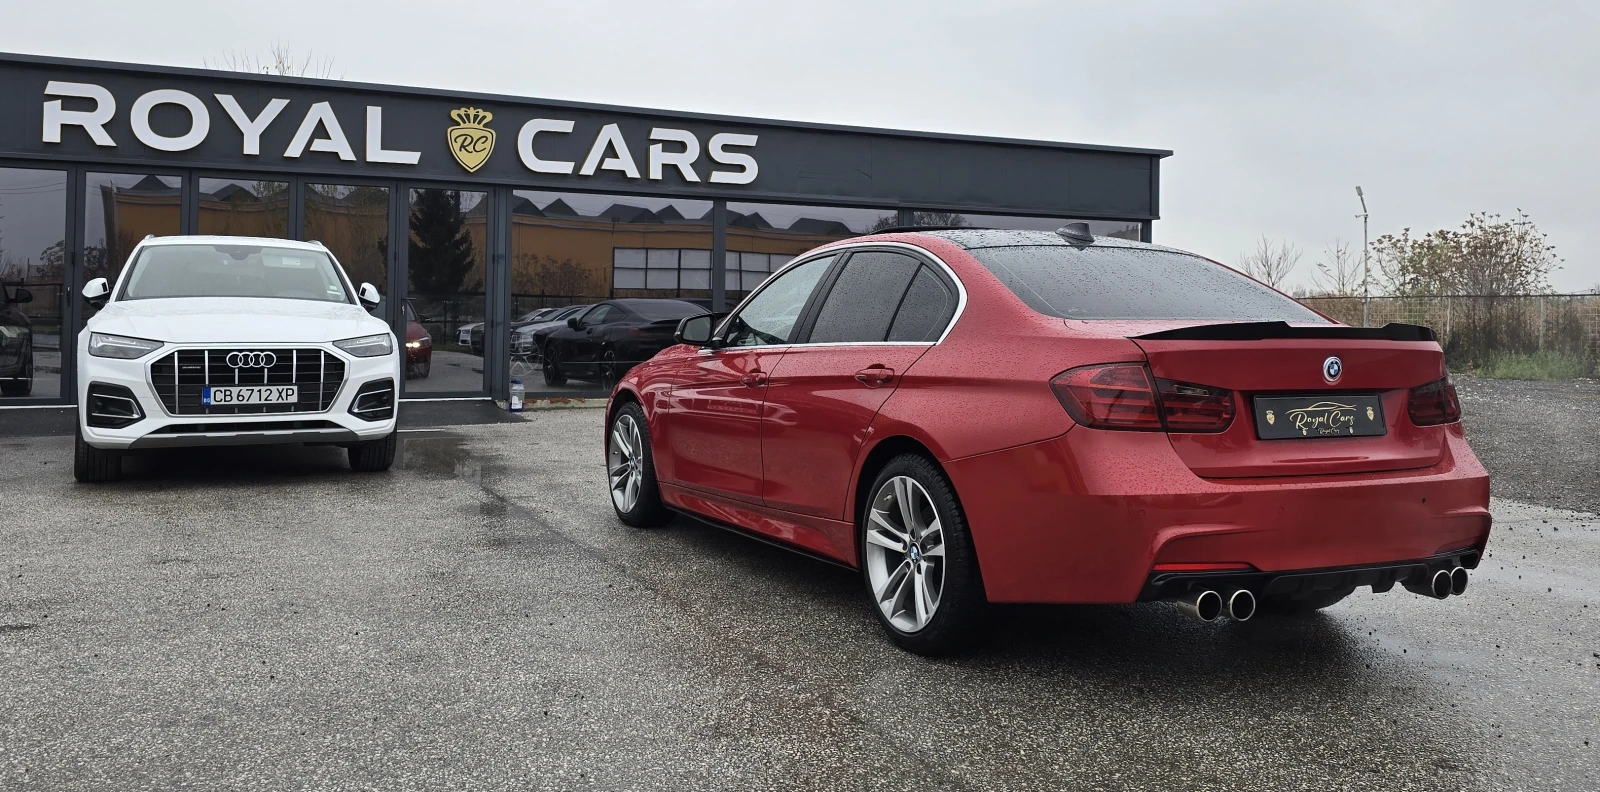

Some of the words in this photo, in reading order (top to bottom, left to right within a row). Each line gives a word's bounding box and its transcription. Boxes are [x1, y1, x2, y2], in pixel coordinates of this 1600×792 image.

[42, 80, 421, 165] ROYAL
[517, 118, 759, 185] CARS
[453, 133, 489, 154] RC
[213, 389, 233, 403] CB
[236, 388, 273, 402] 6712
[276, 387, 295, 401] XP
[1289, 411, 1328, 429] Royal
[1329, 410, 1355, 428] Cars
